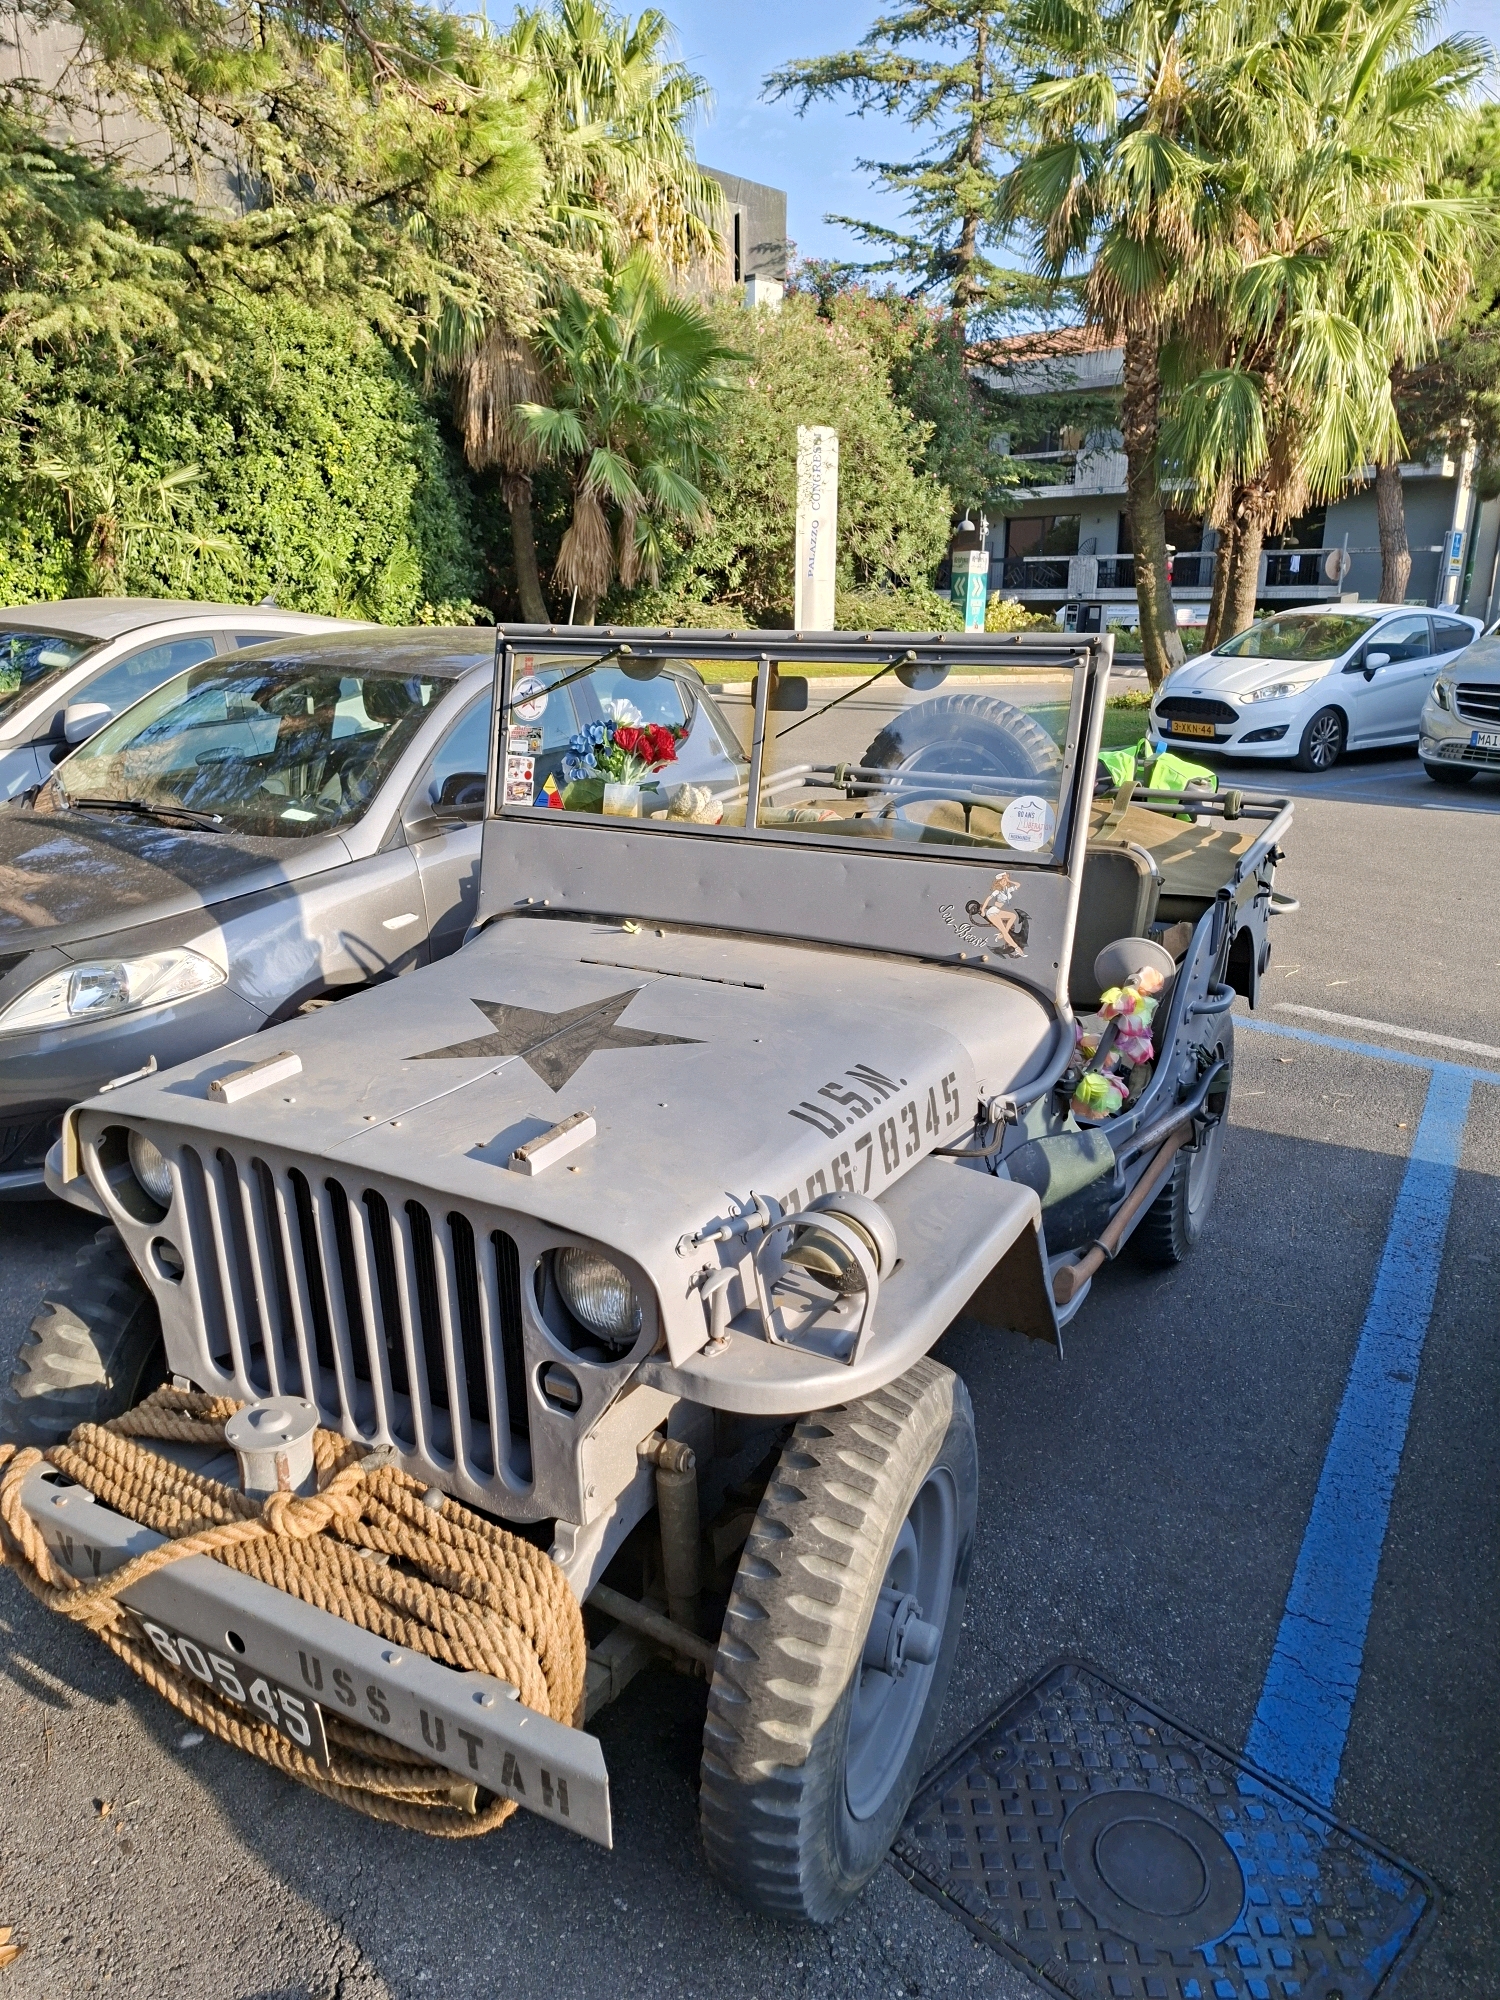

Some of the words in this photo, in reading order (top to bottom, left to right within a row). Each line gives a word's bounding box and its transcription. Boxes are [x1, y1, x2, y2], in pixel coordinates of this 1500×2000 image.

[807, 520, 820, 578] PALAZZO
[1174, 722, 1212, 735] 3-XKN-44
[787, 1063, 908, 1140] U.S.N.
[142, 1621, 311, 1747] 80545
[298, 1651, 391, 1726] USS
[419, 1708, 570, 1818] UTAH
